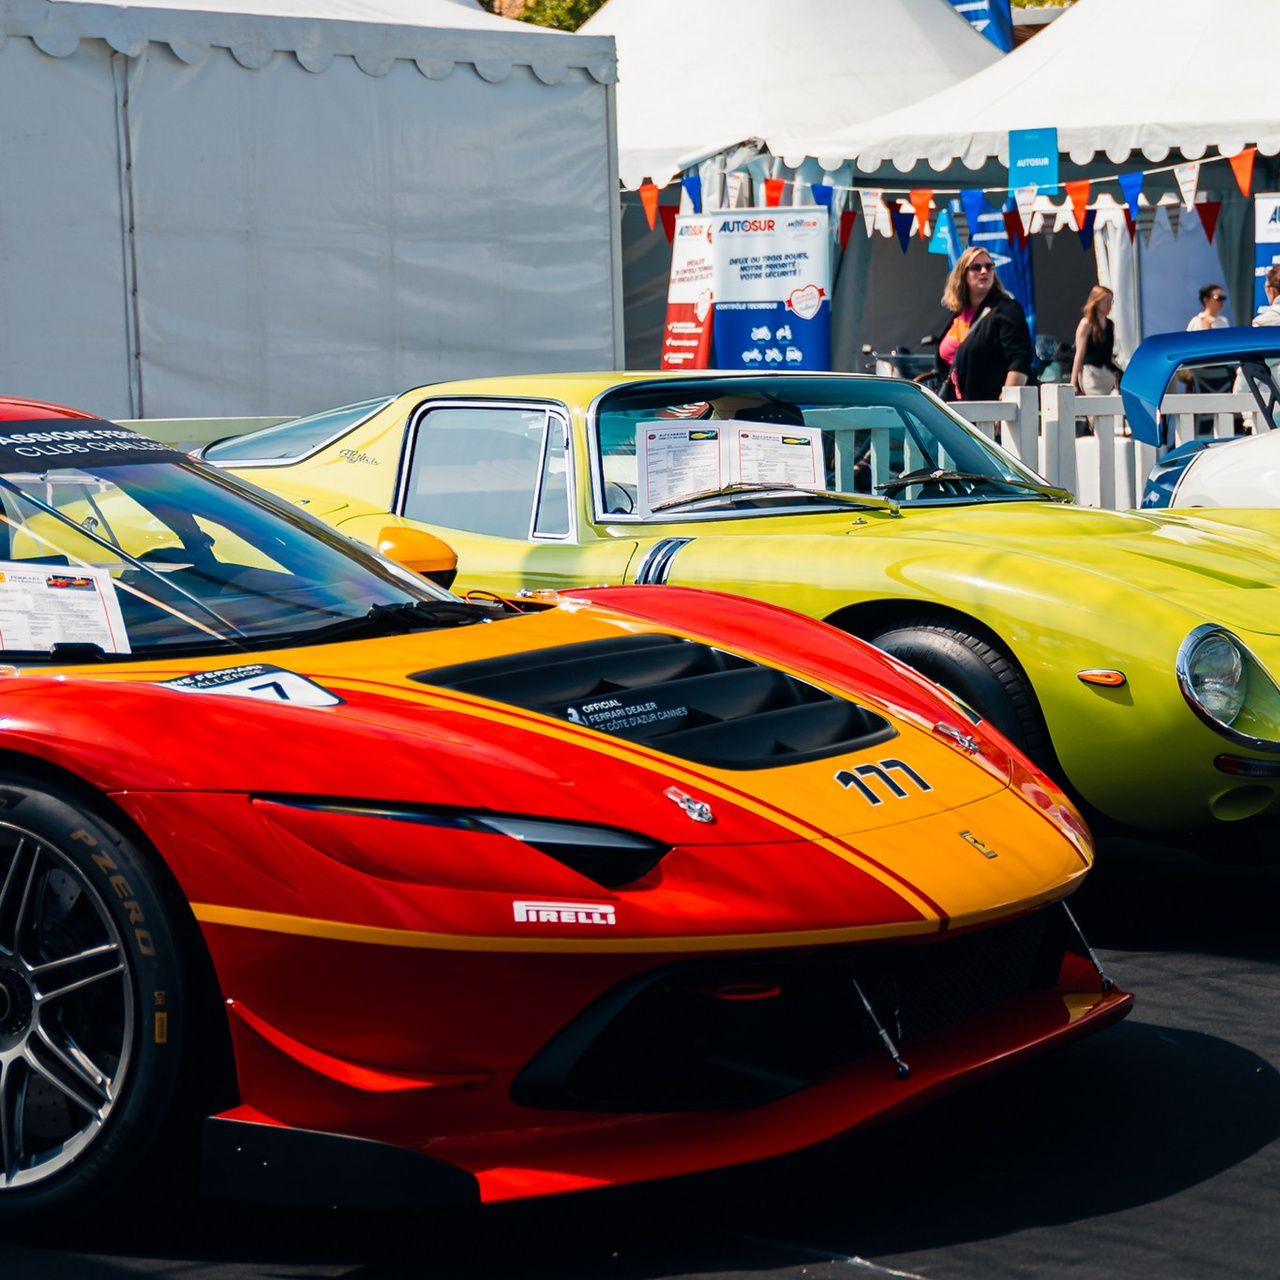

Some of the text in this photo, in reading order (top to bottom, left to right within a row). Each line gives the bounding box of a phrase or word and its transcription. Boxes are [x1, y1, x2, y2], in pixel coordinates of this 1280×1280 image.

[1016, 157, 1049, 168] AUTOSUR
[719, 219, 775, 233] AUTOSUR
[0, 430, 103, 446] ASSIONE
[15, 442, 89, 458] CLUB
[190, 669, 265, 688] ALLENGE
[195, 665, 263, 681] FERRARI
[248, 681, 291, 700] 7
[582, 699, 622, 713] OFFICIAL
[588, 701, 658, 723] FERRARI DEALER
[607, 719, 630, 731] CÔTE
[630, 713, 657, 726] D'AZUR
[657, 707, 688, 721] CANNES
[513, 901, 616, 925] PIRELLI
